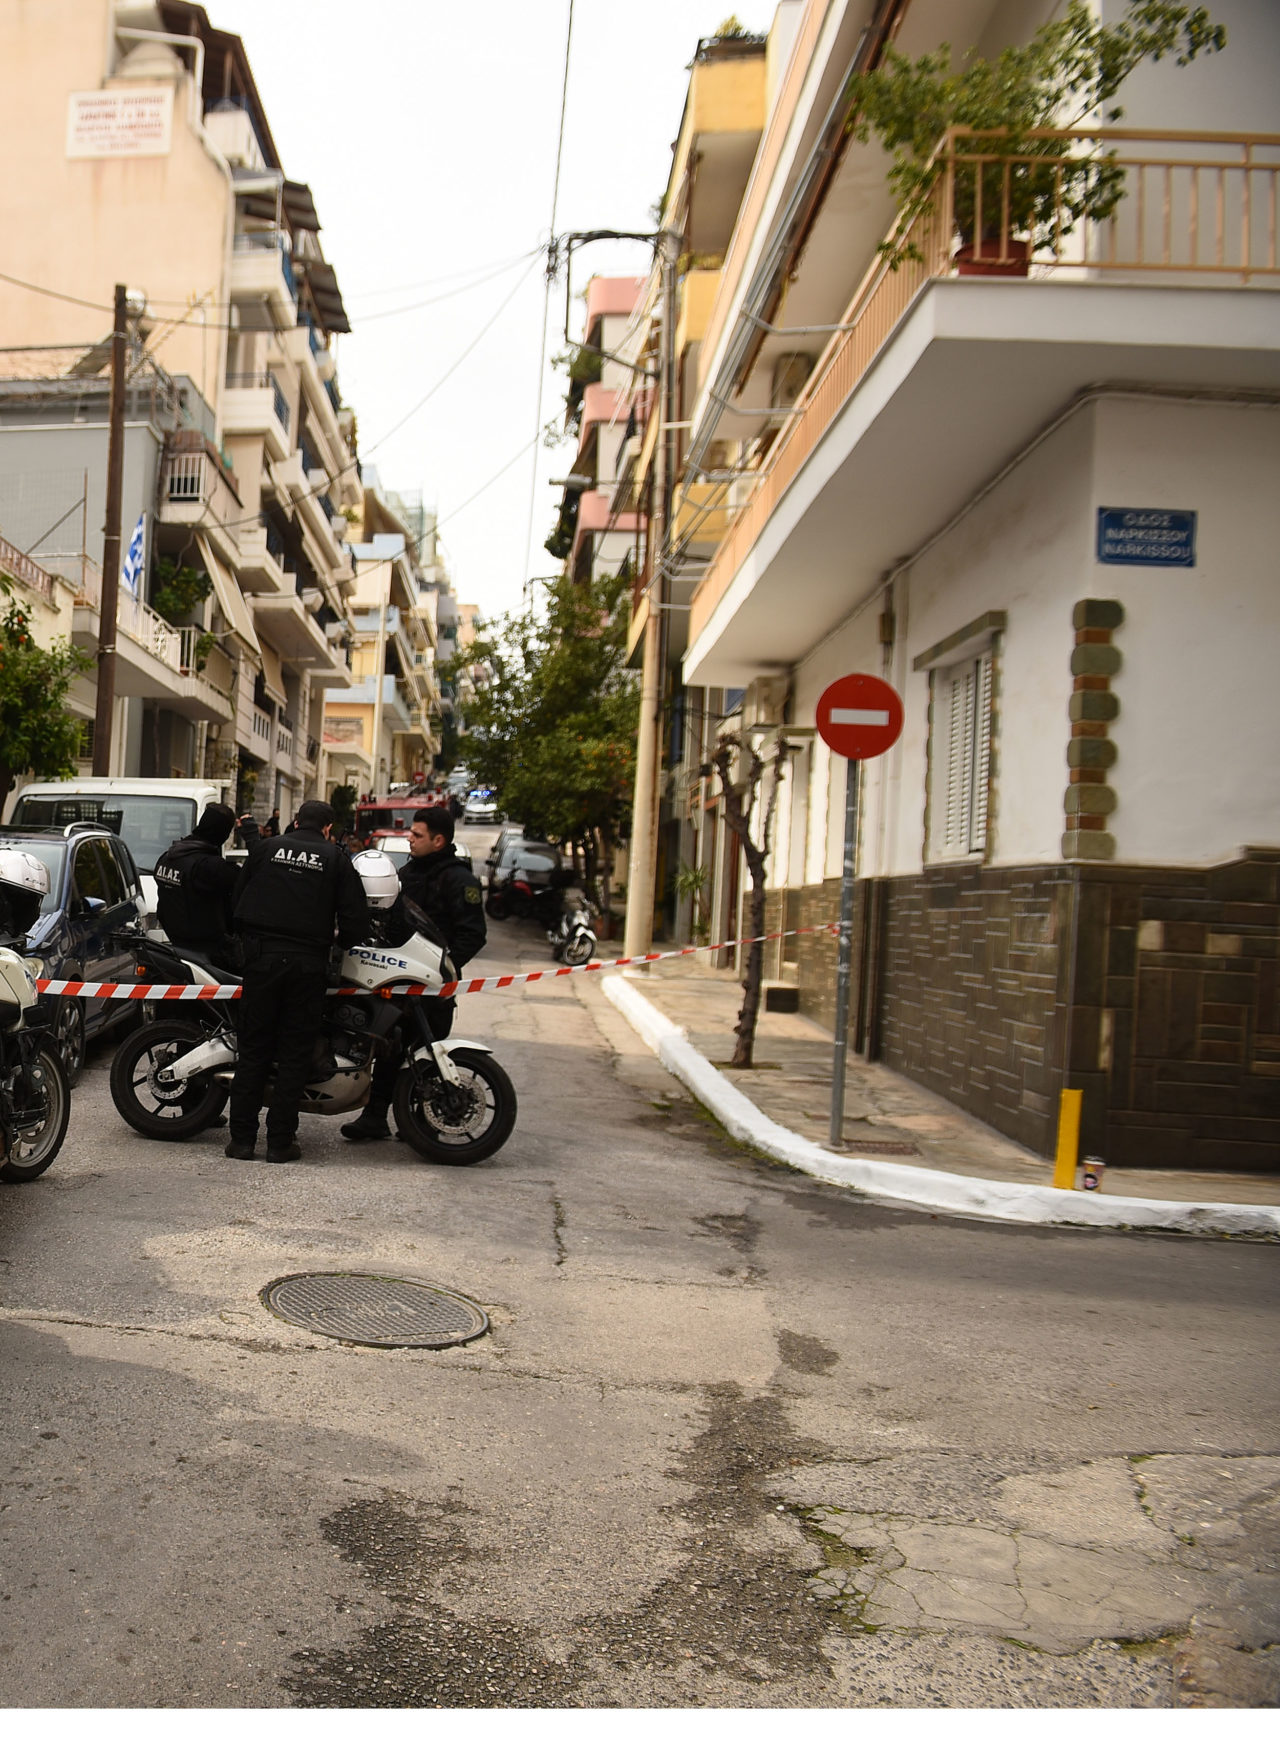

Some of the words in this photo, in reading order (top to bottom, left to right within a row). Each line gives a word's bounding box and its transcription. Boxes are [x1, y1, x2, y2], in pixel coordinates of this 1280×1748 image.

[1122, 512, 1173, 527] ΟΔΟΣ
[1106, 527, 1190, 543] ΝΑΡΚΙΣΣΟΥ
[1103, 542, 1191, 560] NARKISSOU
[348, 949, 409, 970] POLICE
[360, 960, 388, 970] Kawasaki
